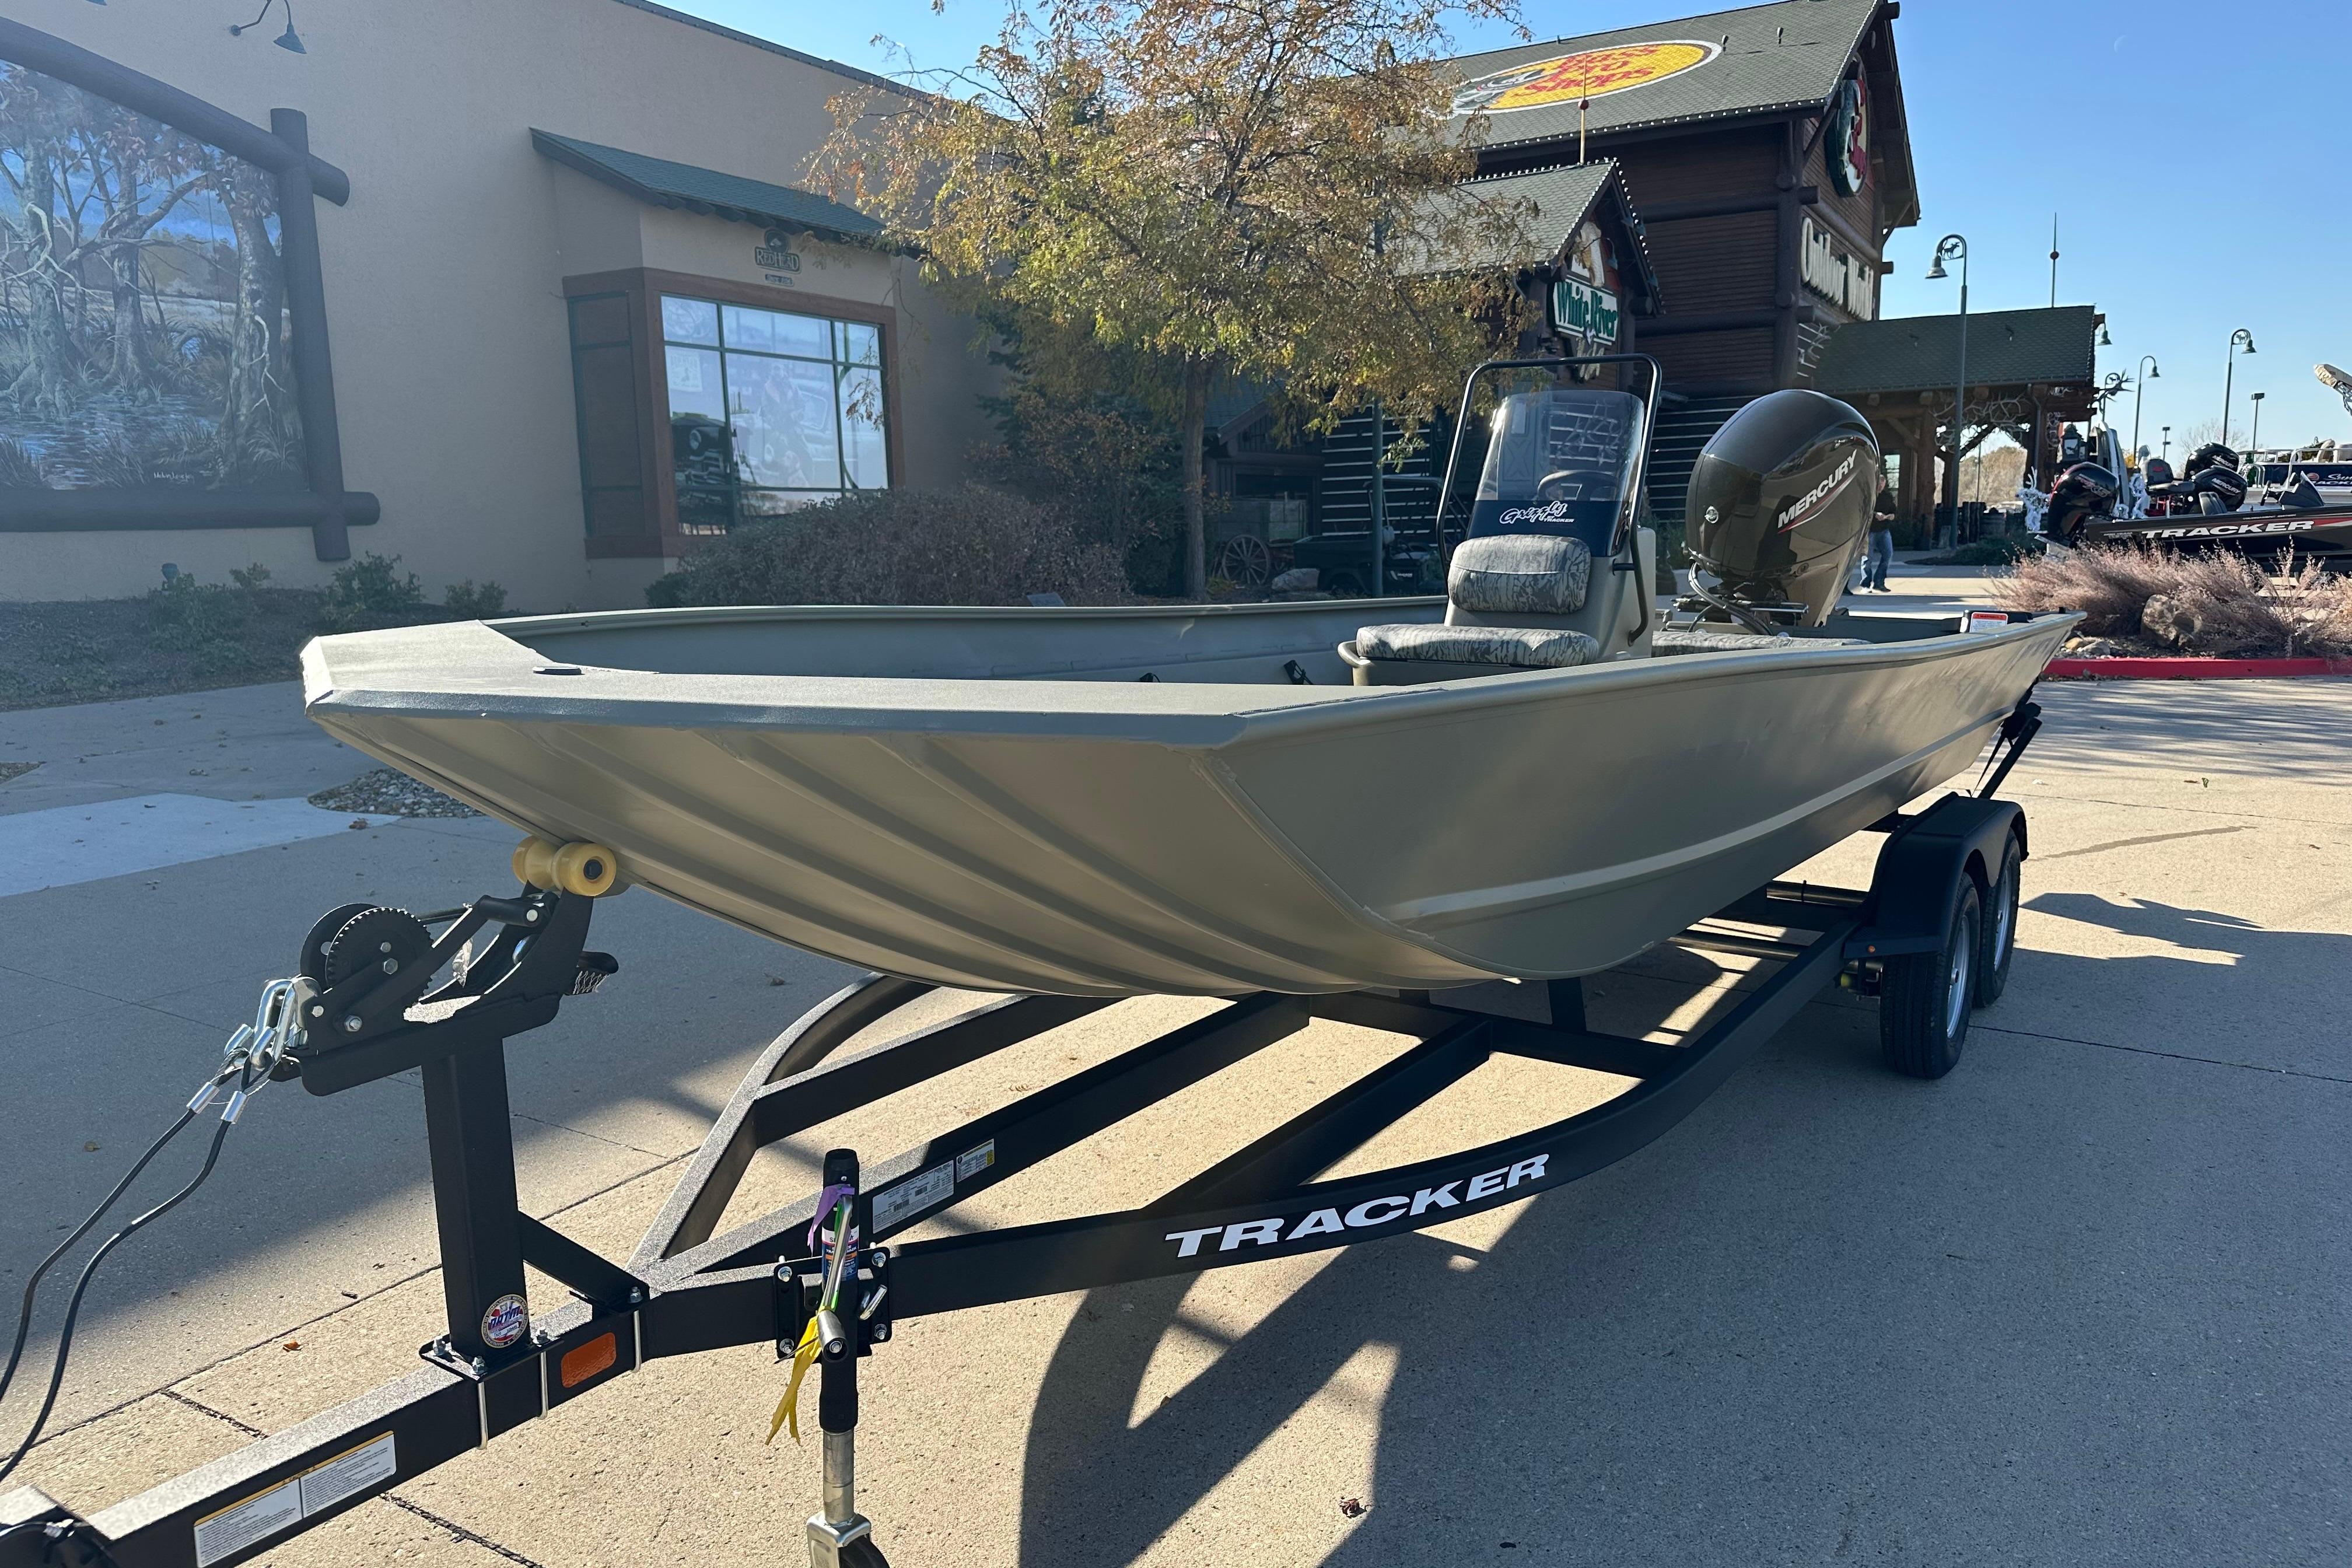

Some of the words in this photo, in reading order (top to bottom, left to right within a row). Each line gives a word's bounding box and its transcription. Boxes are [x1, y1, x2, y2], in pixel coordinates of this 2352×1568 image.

[1801, 216, 1847, 305] Outdoor
[1556, 280, 1590, 332] White
[1590, 289, 1618, 338] River
[1499, 501, 1568, 524] Grizzly
[1777, 449, 1857, 528] MERCURY
[2211, 478, 2241, 494] MERCURY
[2141, 520, 2315, 539] TRACKER
[1165, 1153, 1550, 1258] TRACKER
